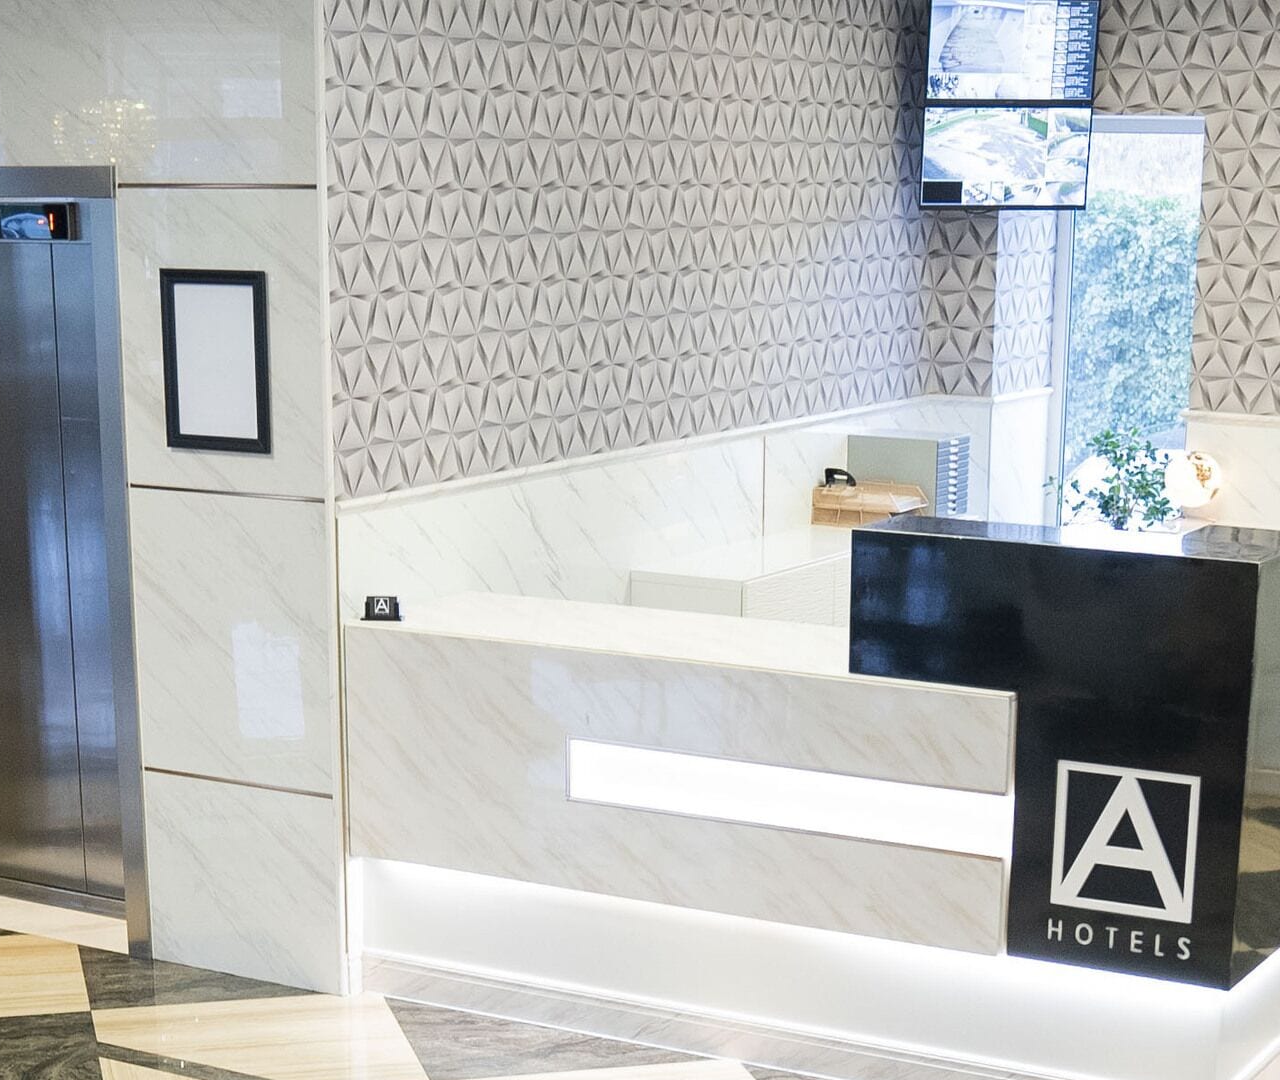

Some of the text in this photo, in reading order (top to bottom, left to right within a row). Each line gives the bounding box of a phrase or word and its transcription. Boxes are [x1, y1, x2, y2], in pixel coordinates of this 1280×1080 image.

[375, 598, 389, 614] A
[1050, 760, 1201, 924] A
[1047, 918, 1192, 960] HOTELS
